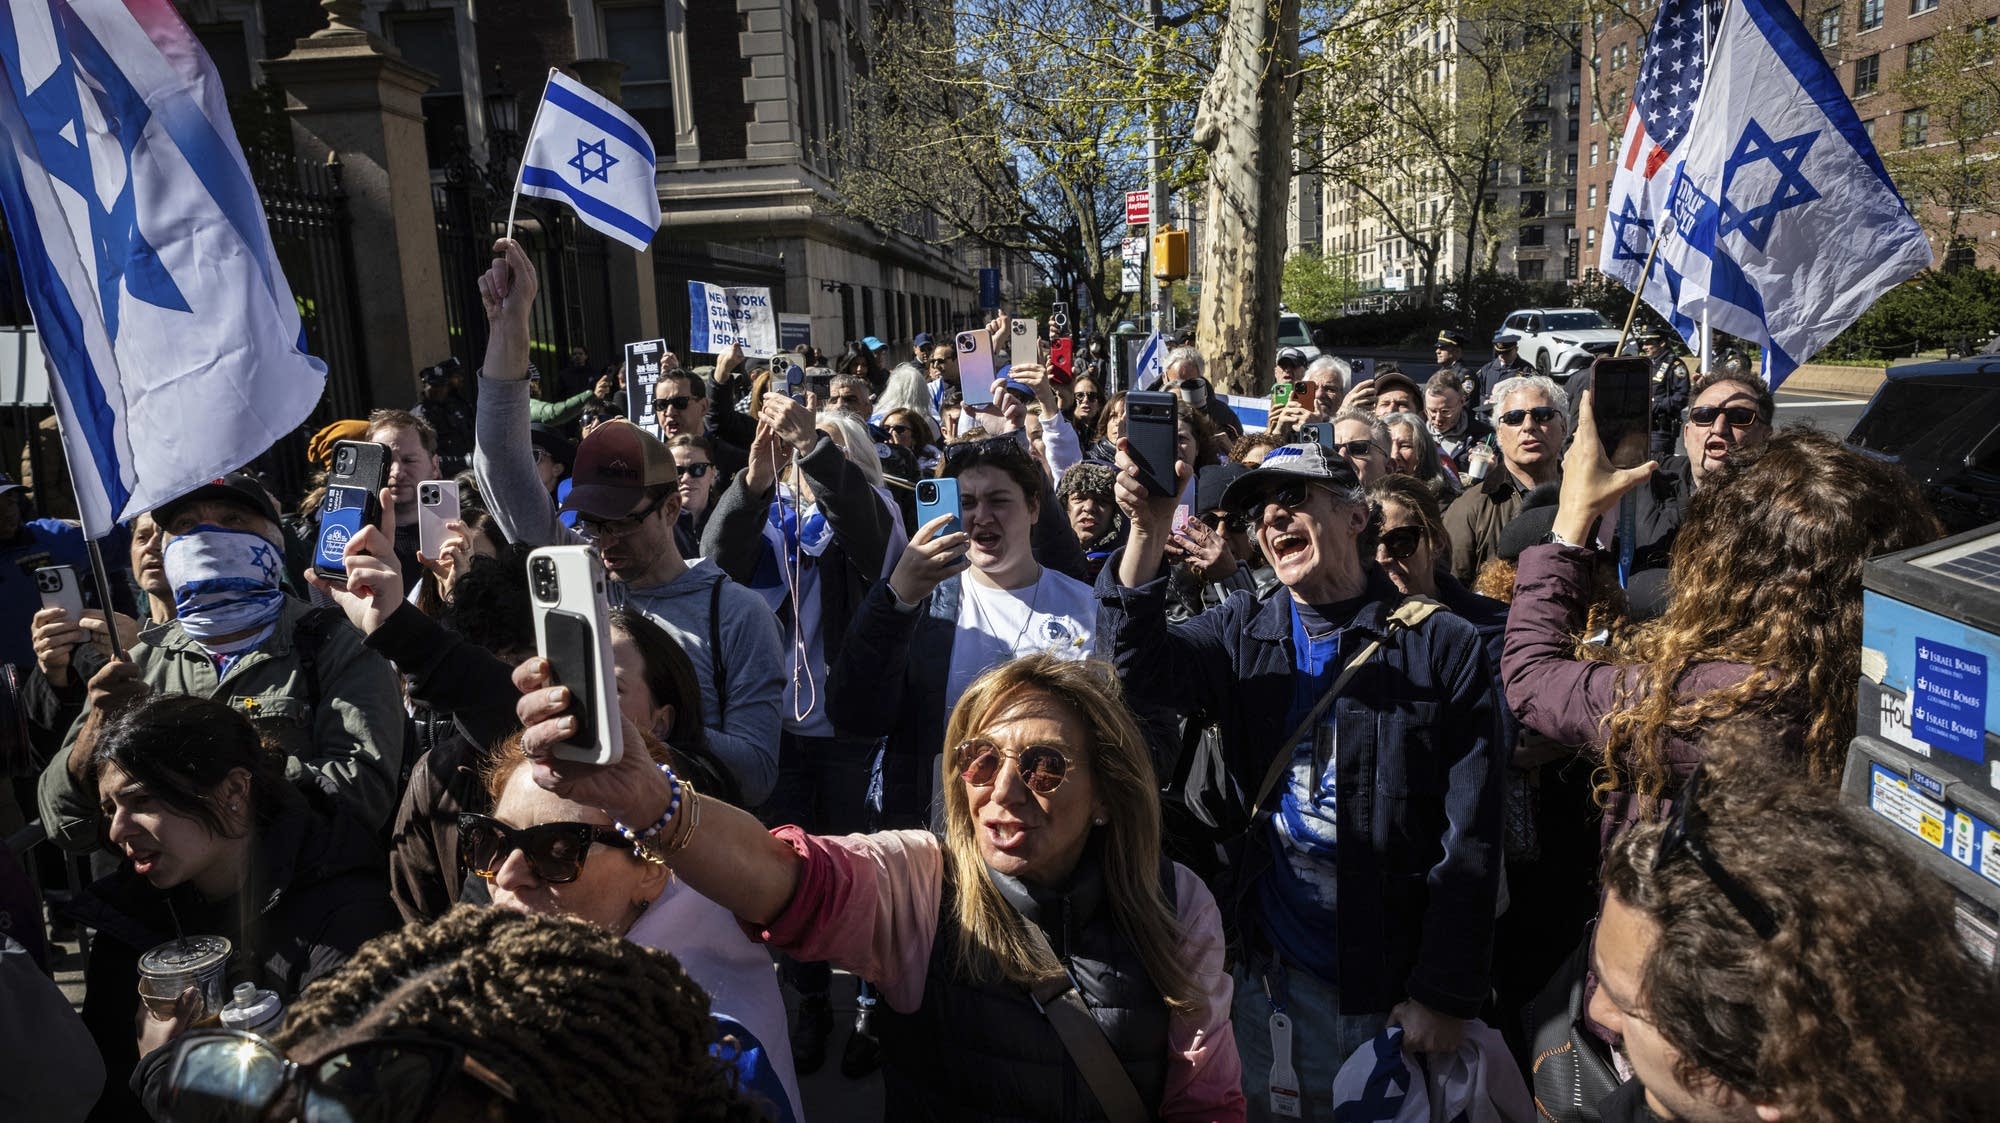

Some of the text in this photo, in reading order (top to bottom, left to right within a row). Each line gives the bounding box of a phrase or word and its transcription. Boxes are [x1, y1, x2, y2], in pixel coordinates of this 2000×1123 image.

[1136, 194, 1149, 202] STAN
[1128, 203, 1148, 211] Anytime
[708, 292, 767, 307] NEW YORK
[711, 306, 752, 320] STANDS
[712, 320, 740, 334] WITH
[713, 333, 751, 348] ISRAEL
[1930, 651, 1982, 676] ISRAEL BOMBS
[1928, 681, 1980, 709] ISRAEL BOMBS
[1926, 711, 1978, 740] ISRAEL BOMBS
